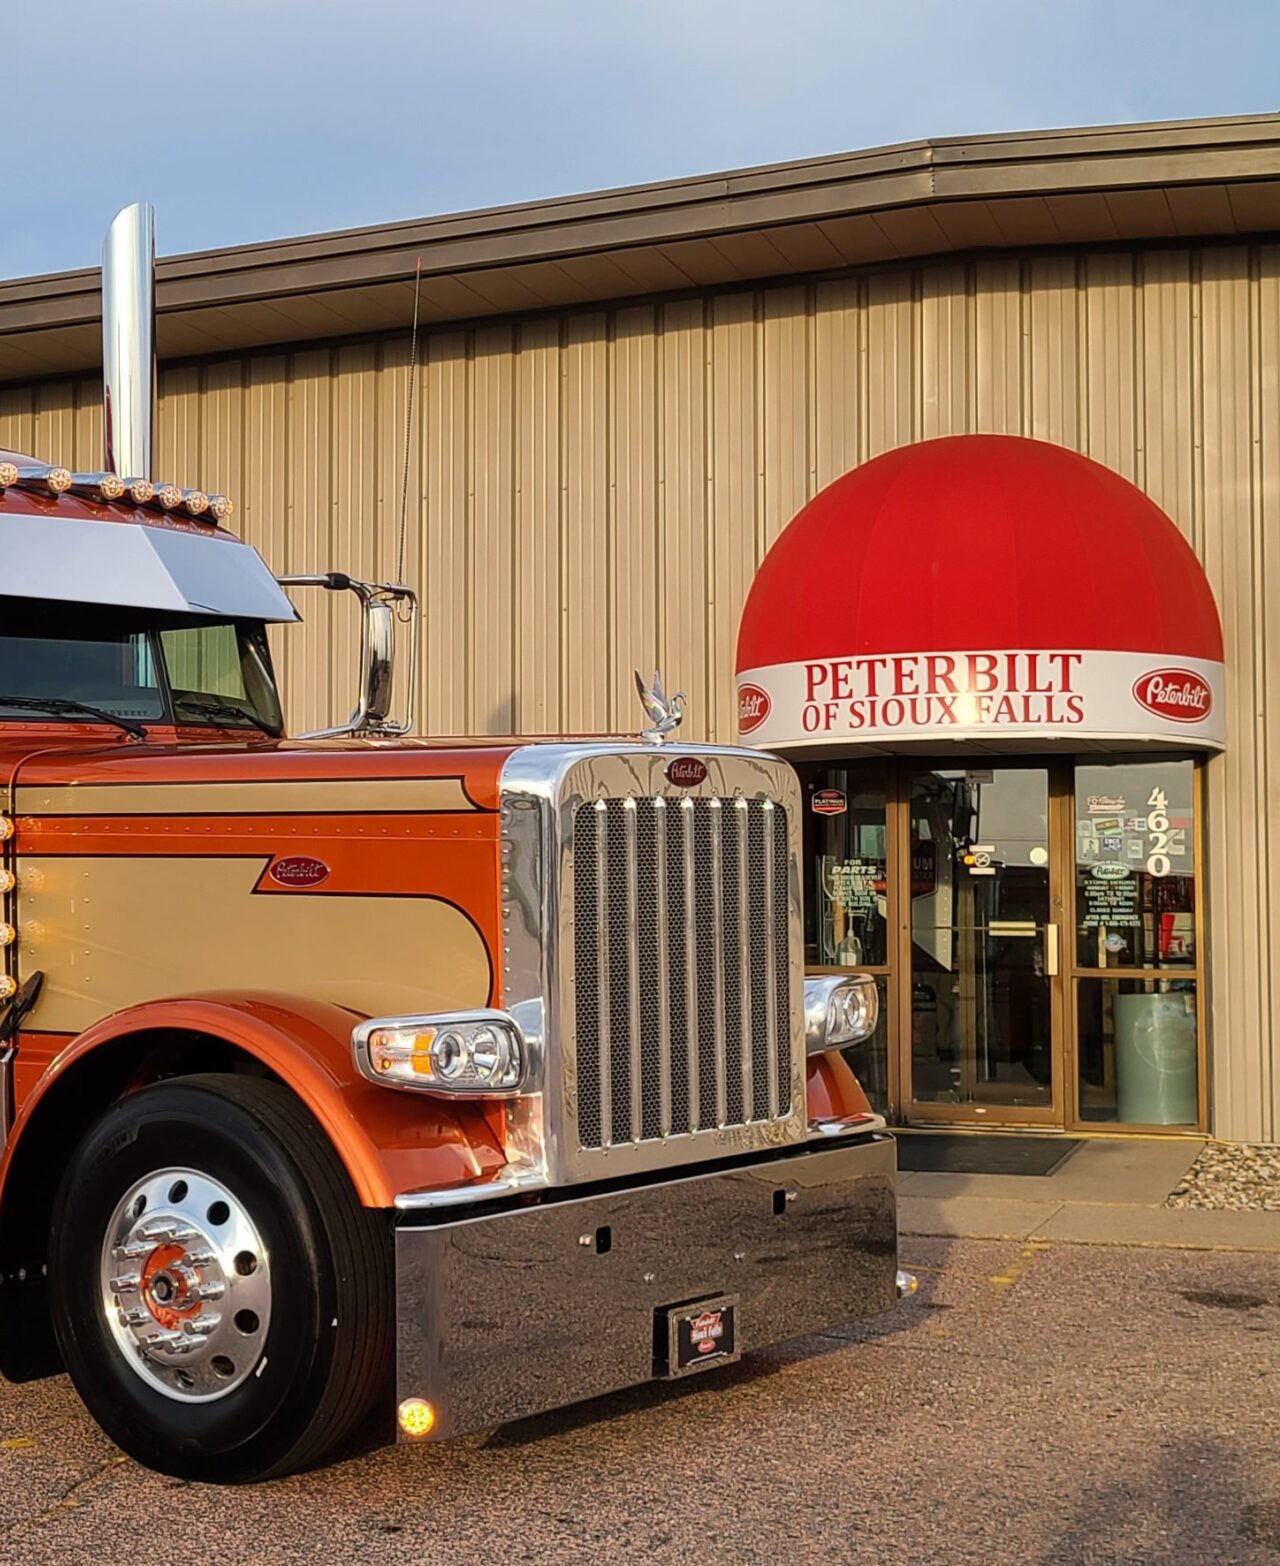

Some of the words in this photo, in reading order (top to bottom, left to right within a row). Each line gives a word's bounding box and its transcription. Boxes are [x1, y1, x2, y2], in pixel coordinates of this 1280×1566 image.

[804, 653, 1082, 702] PETERBILT
[1146, 676, 1208, 709] Peterbilt
[802, 702, 839, 733] OF
[849, 695, 959, 729] SIOUX
[974, 695, 1084, 724] FALLS
[1147, 786, 1171, 878] 4620
[832, 866, 877, 875] PARTS
